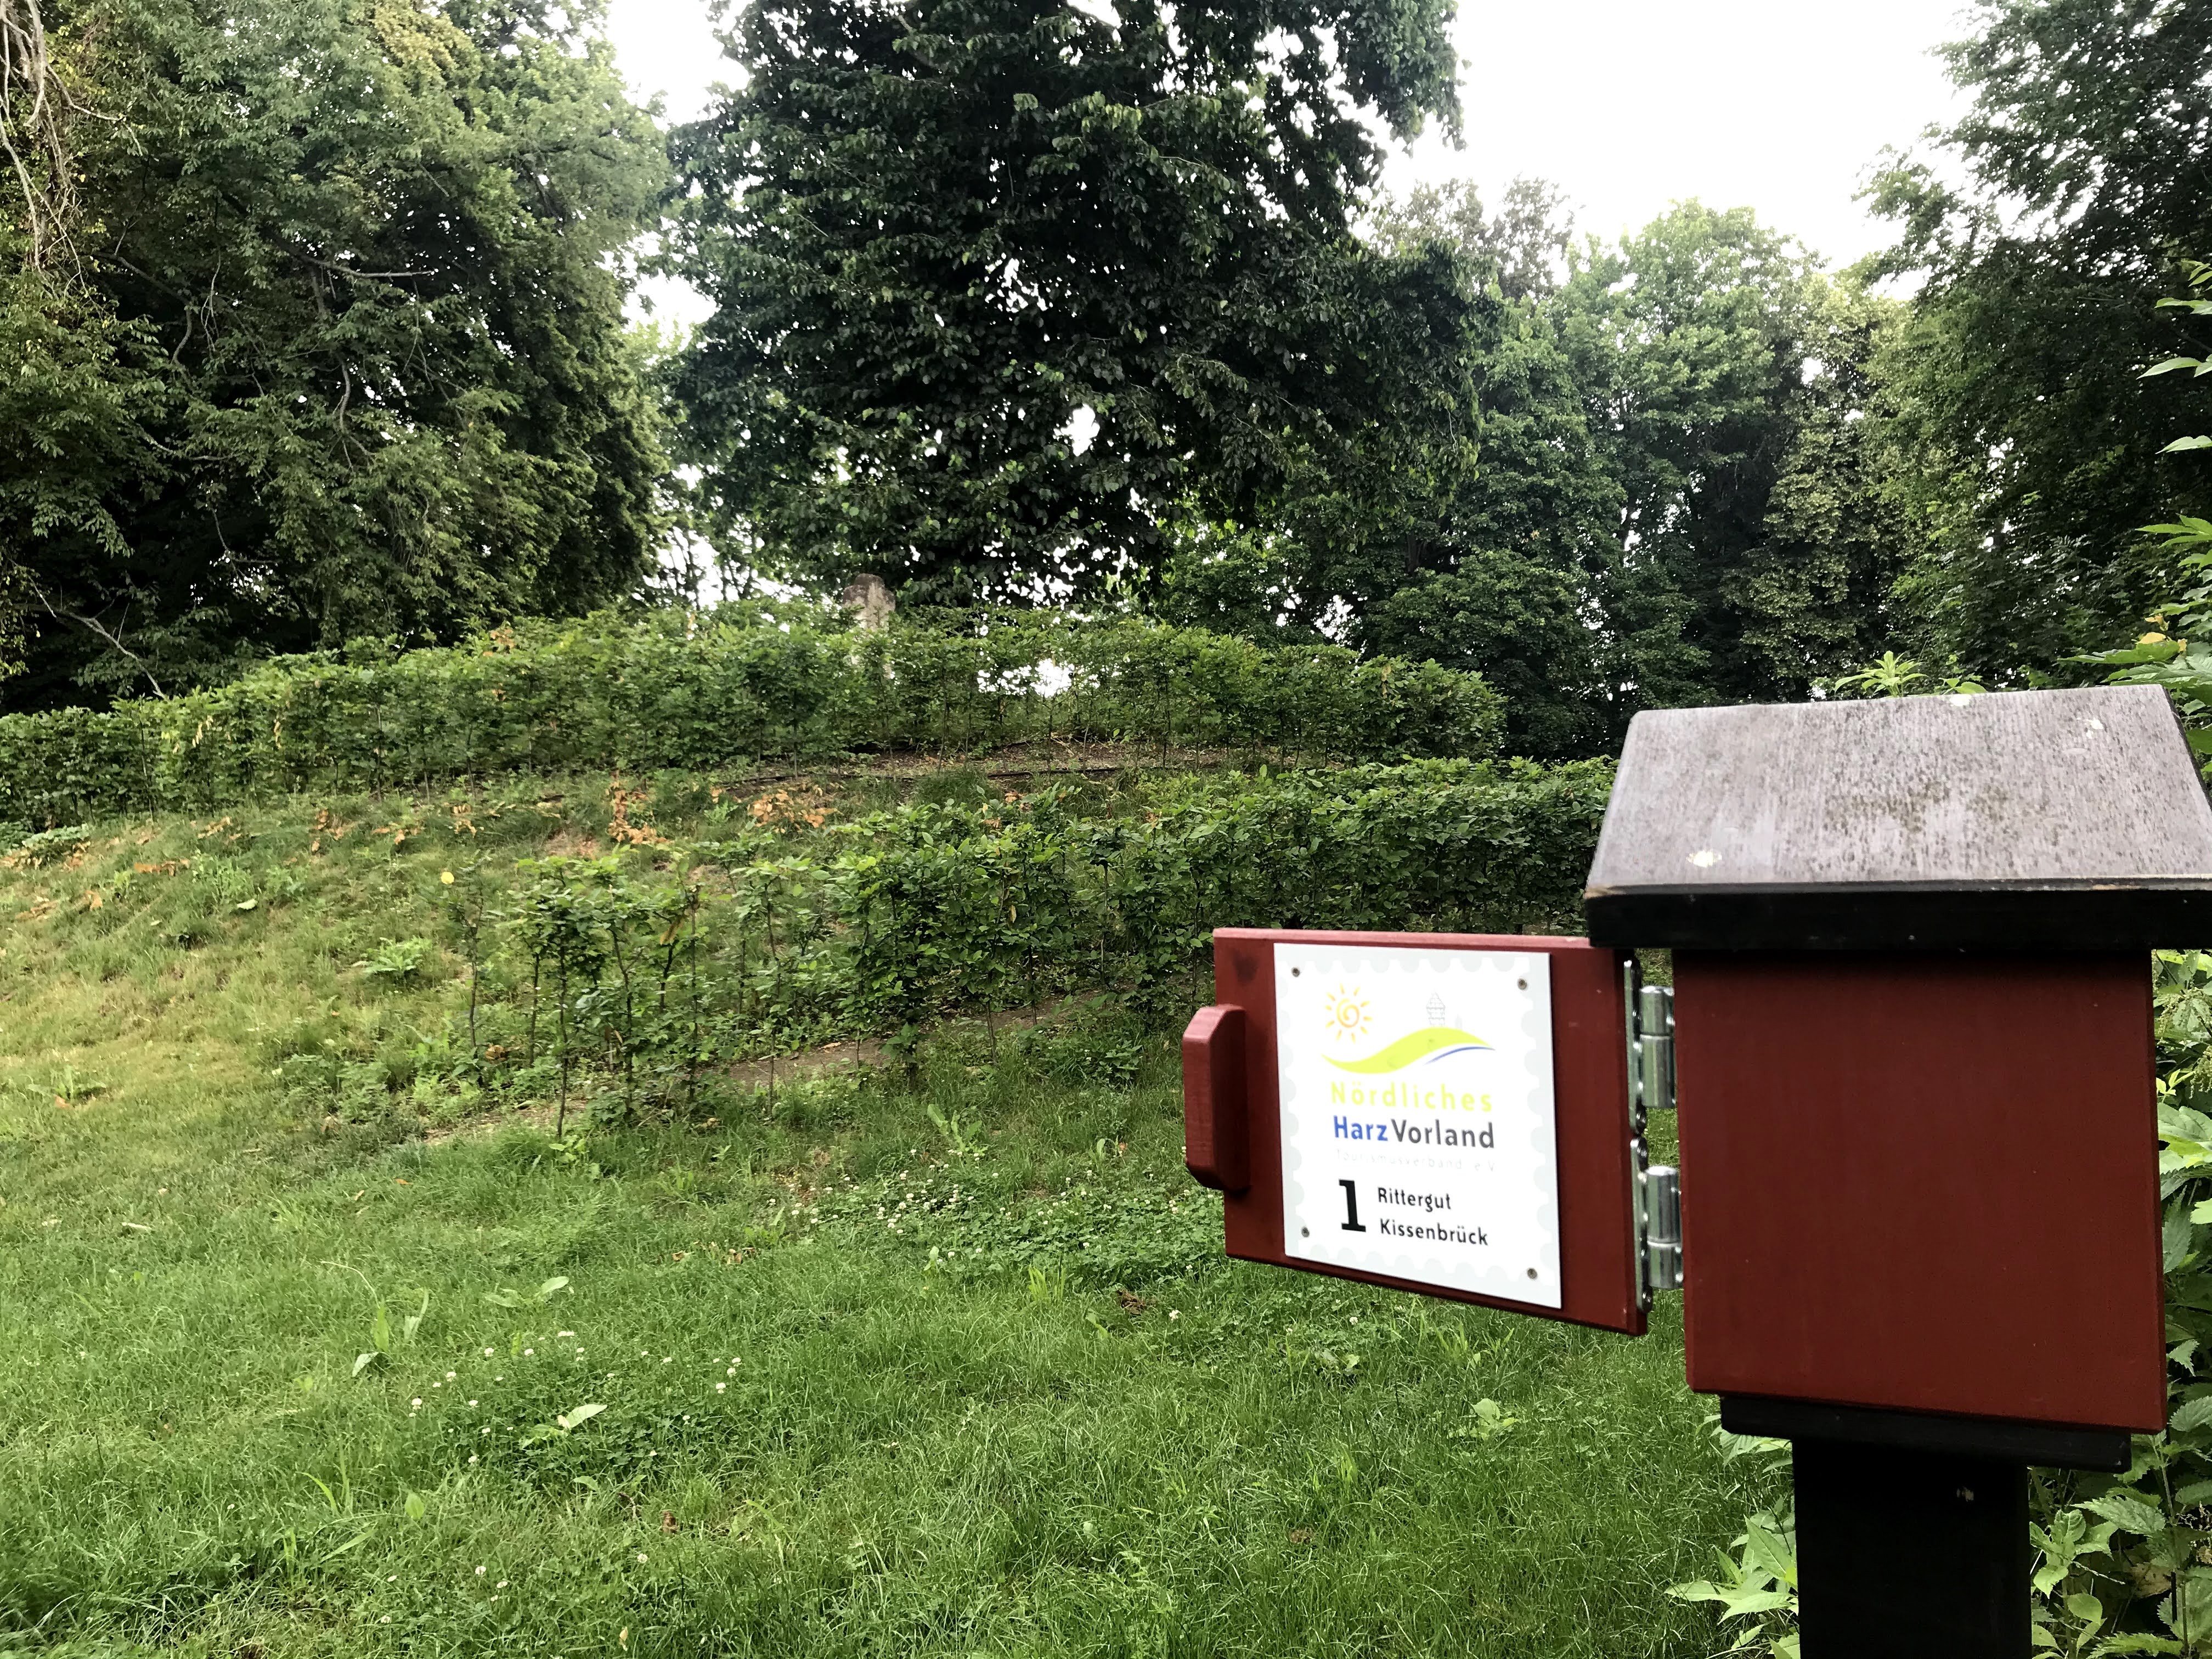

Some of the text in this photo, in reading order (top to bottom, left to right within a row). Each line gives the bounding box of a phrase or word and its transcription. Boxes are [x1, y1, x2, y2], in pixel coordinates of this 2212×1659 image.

[1330, 1081, 1492, 1113] Nördliches
[1333, 1115, 1494, 1149] HarzVorland
[1338, 1179, 1367, 1233] 1
[1378, 1187, 1451, 1213] Rittergut
[1380, 1218, 1488, 1246] Kissenbrück
